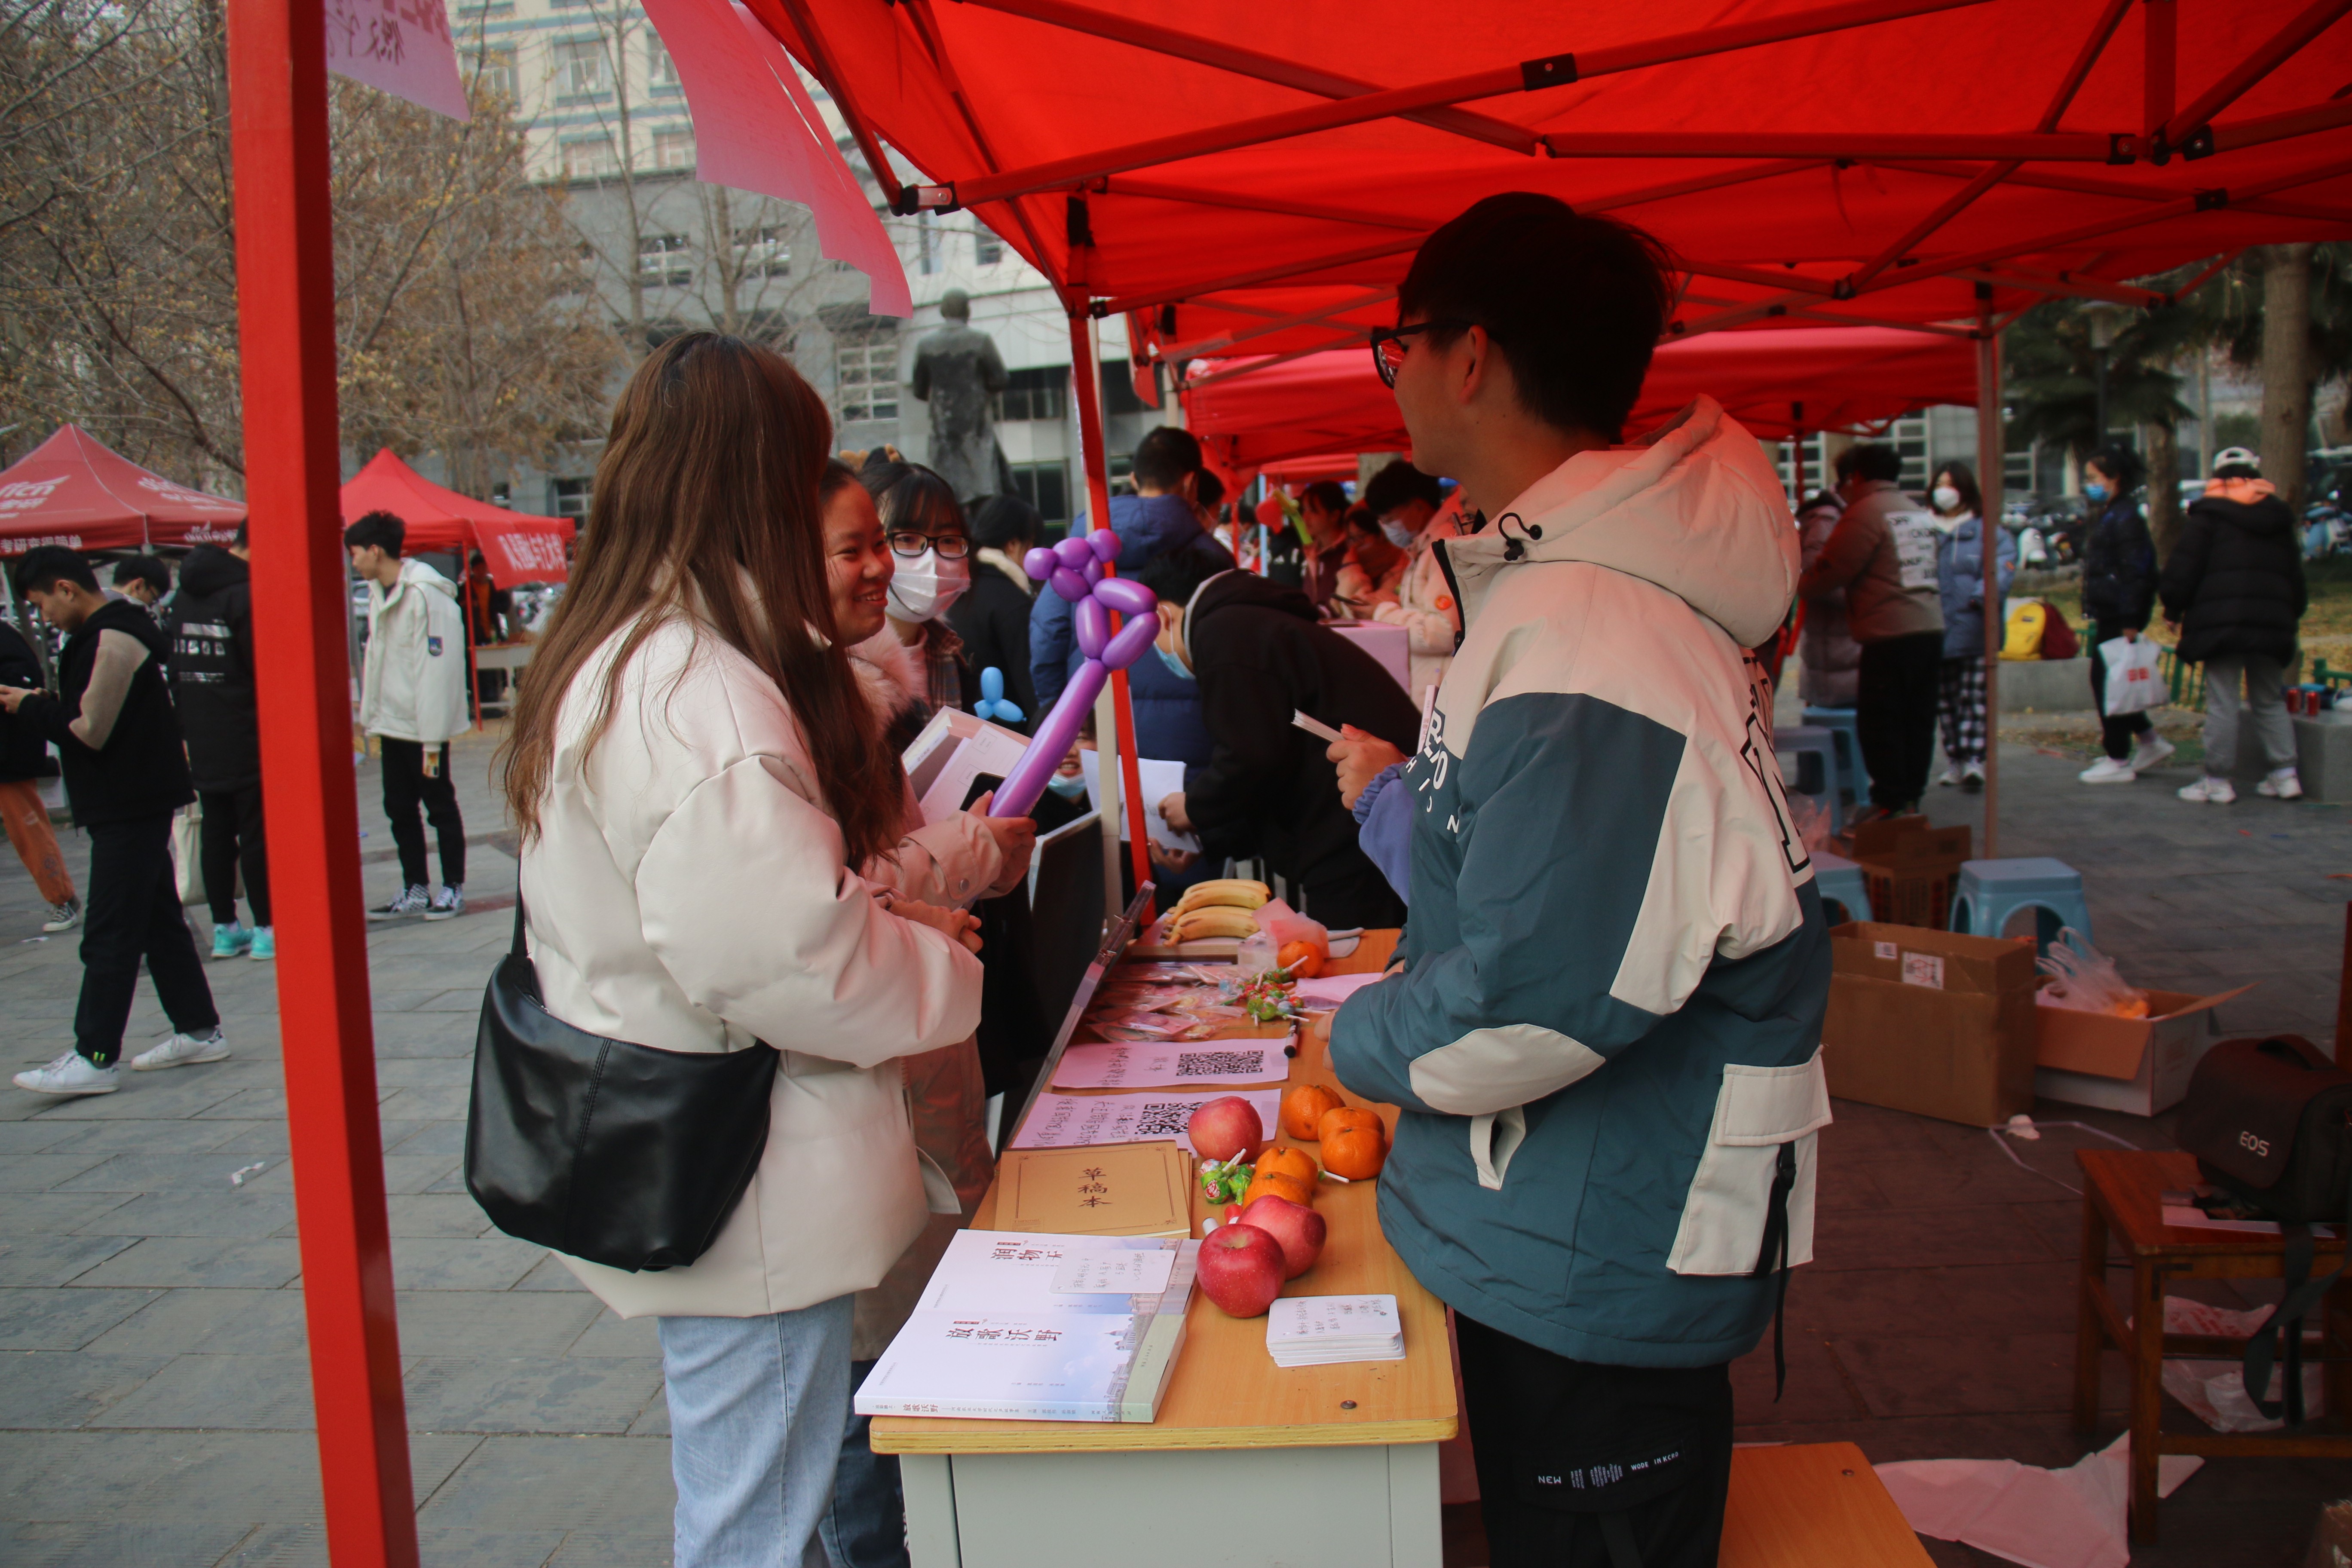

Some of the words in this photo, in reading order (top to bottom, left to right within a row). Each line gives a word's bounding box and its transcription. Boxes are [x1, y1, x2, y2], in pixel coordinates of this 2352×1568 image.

[2240, 1131, 2270, 1157] EOS
[1078, 1167, 1113, 1207] 草稿本
[945, 1328, 1063, 1341] 放歌沃野
[903, 1403, 938, 1412] 放歌沃野
[1538, 1476, 1562, 1484] NEW
[1631, 1461, 1649, 1470] WODE
